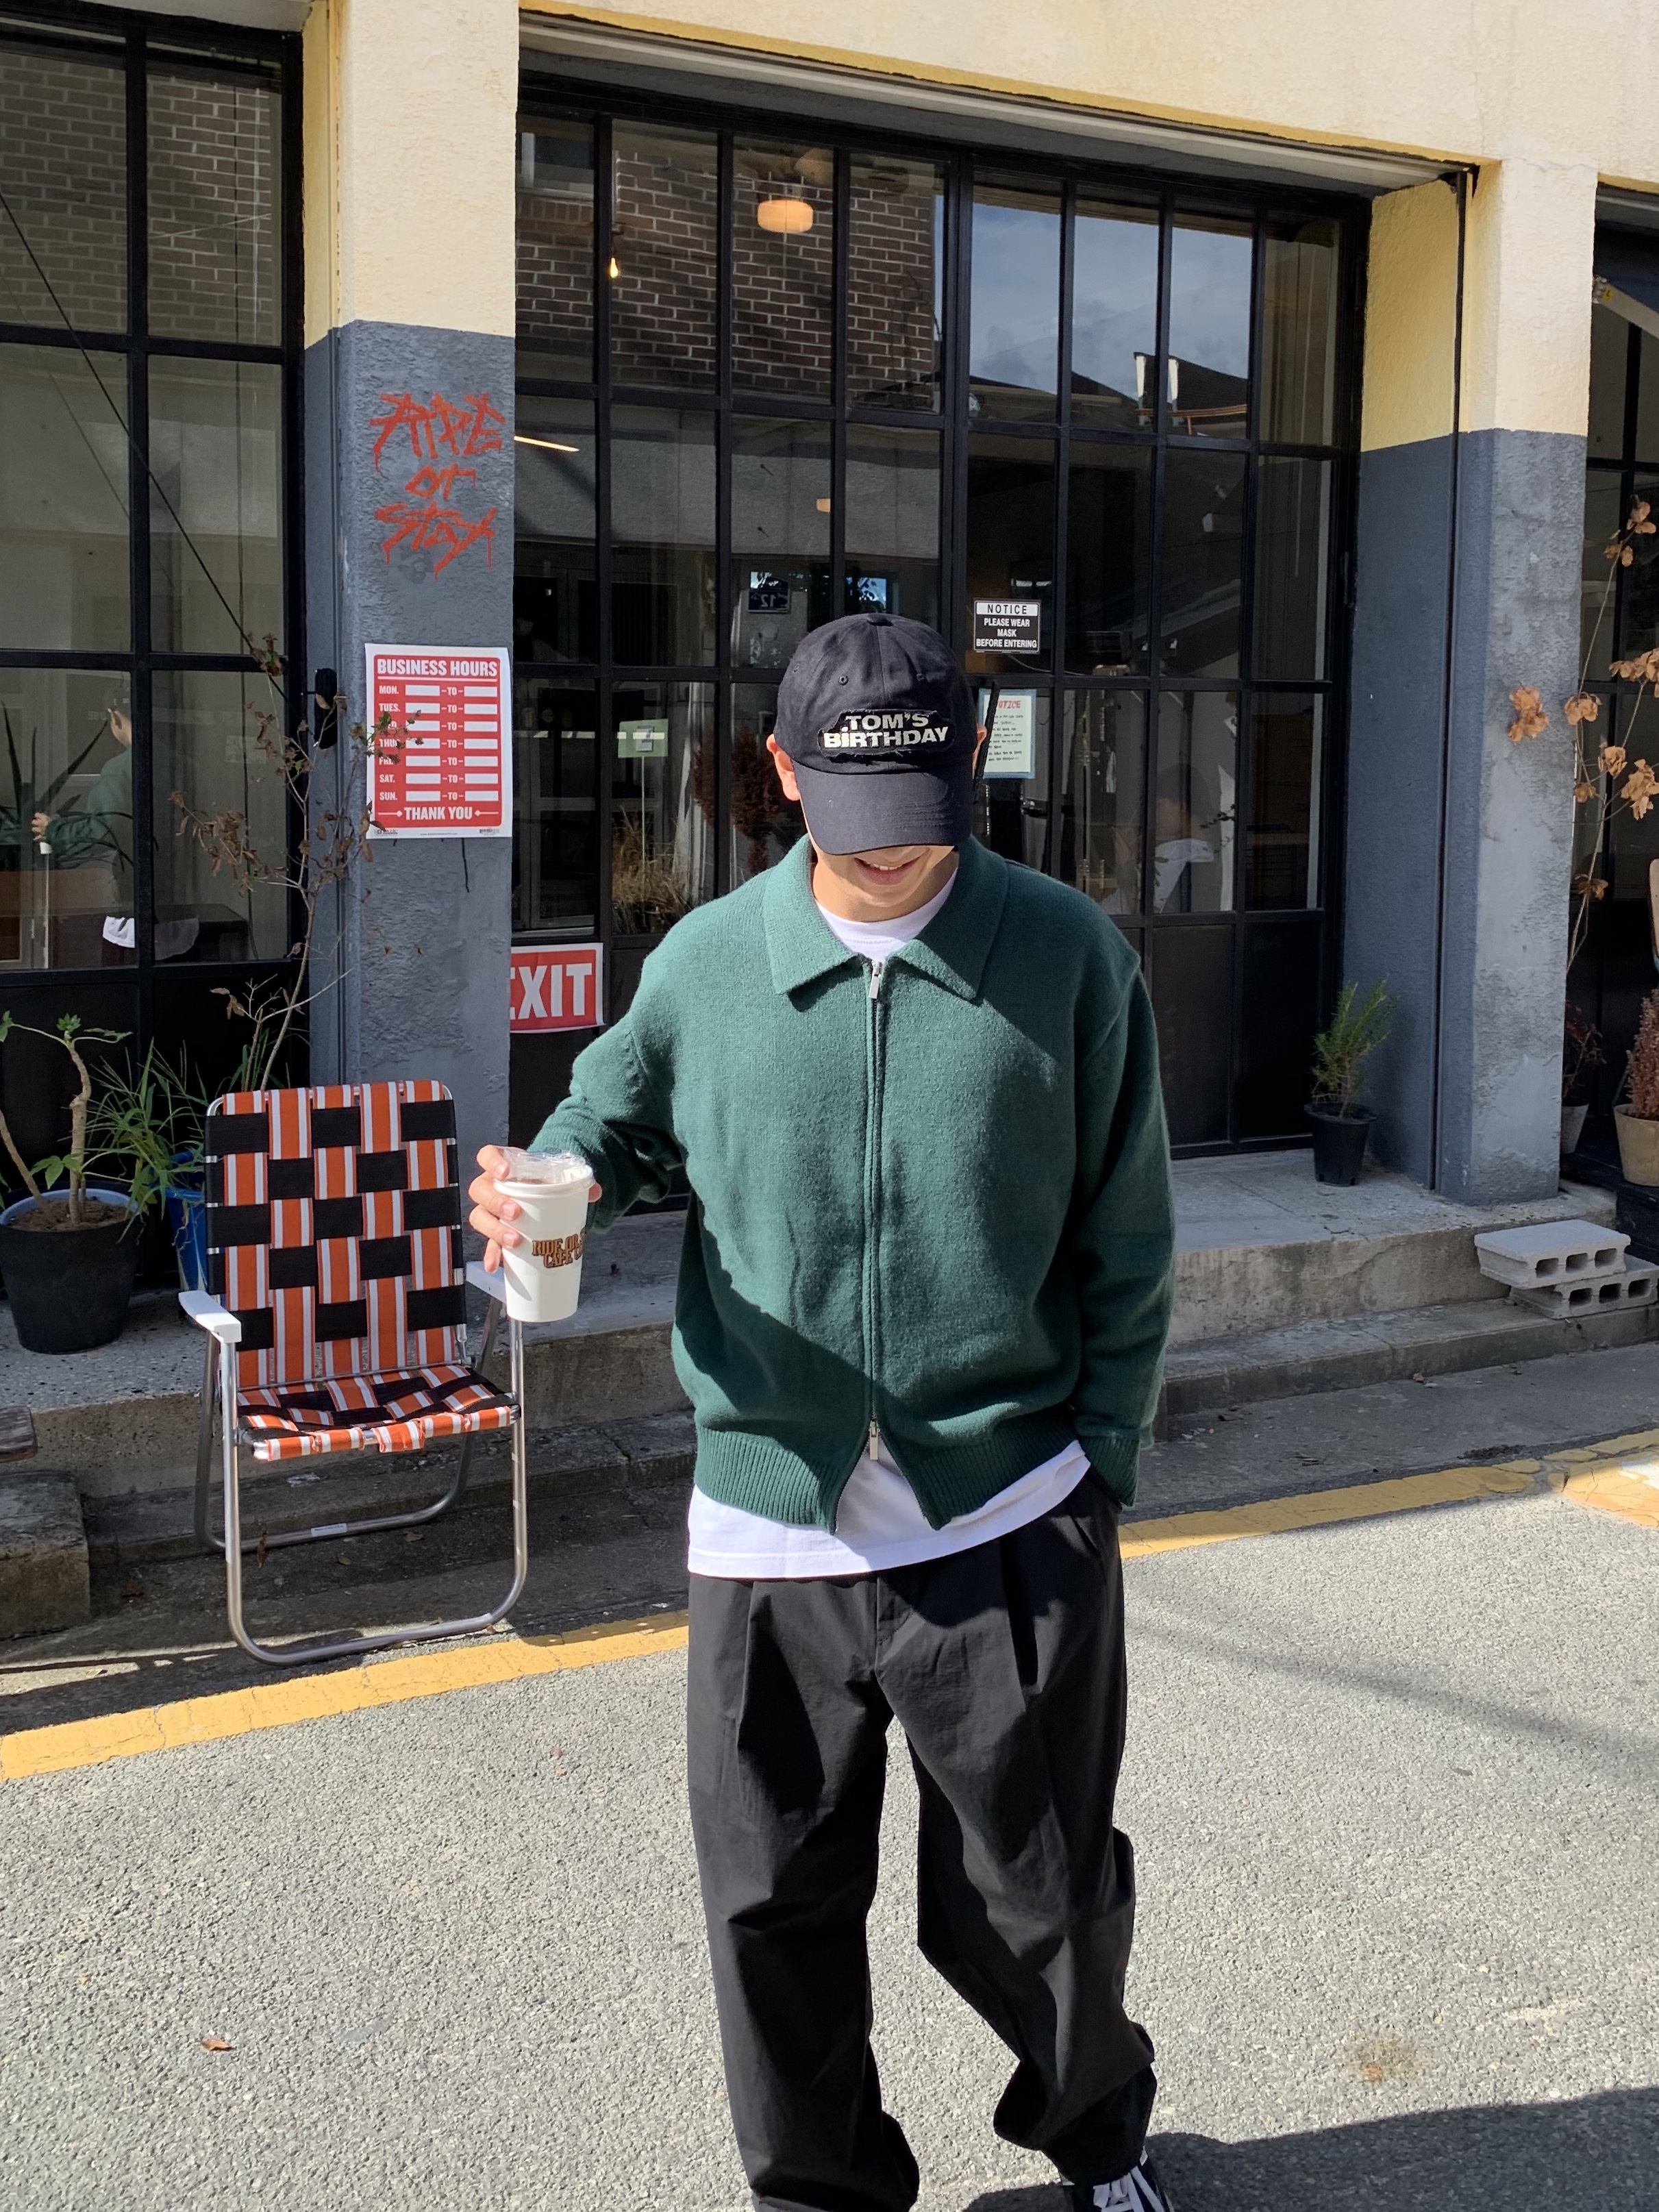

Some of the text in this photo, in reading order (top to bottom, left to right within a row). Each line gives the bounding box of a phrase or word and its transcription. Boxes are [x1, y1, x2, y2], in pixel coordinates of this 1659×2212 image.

[988, 604, 1027, 615] NOTICE
[984, 618, 1030, 627] PLEASE WEAR
[997, 629, 1017, 638] MASK
[976, 638, 1037, 649] BEFORE ENTERING
[377, 659, 498, 677] BUSINESS HOURS
[379, 686, 399, 695] MON.
[379, 703, 401, 712] TUES.
[998, 700, 1021, 709] OTICE
[845, 713, 929, 731] TOM'S
[379, 774, 395, 783] SAT.
[379, 792, 398, 801] SUN.
[404, 806, 473, 821] THANK YOU
[510, 962, 592, 1020] XIT
